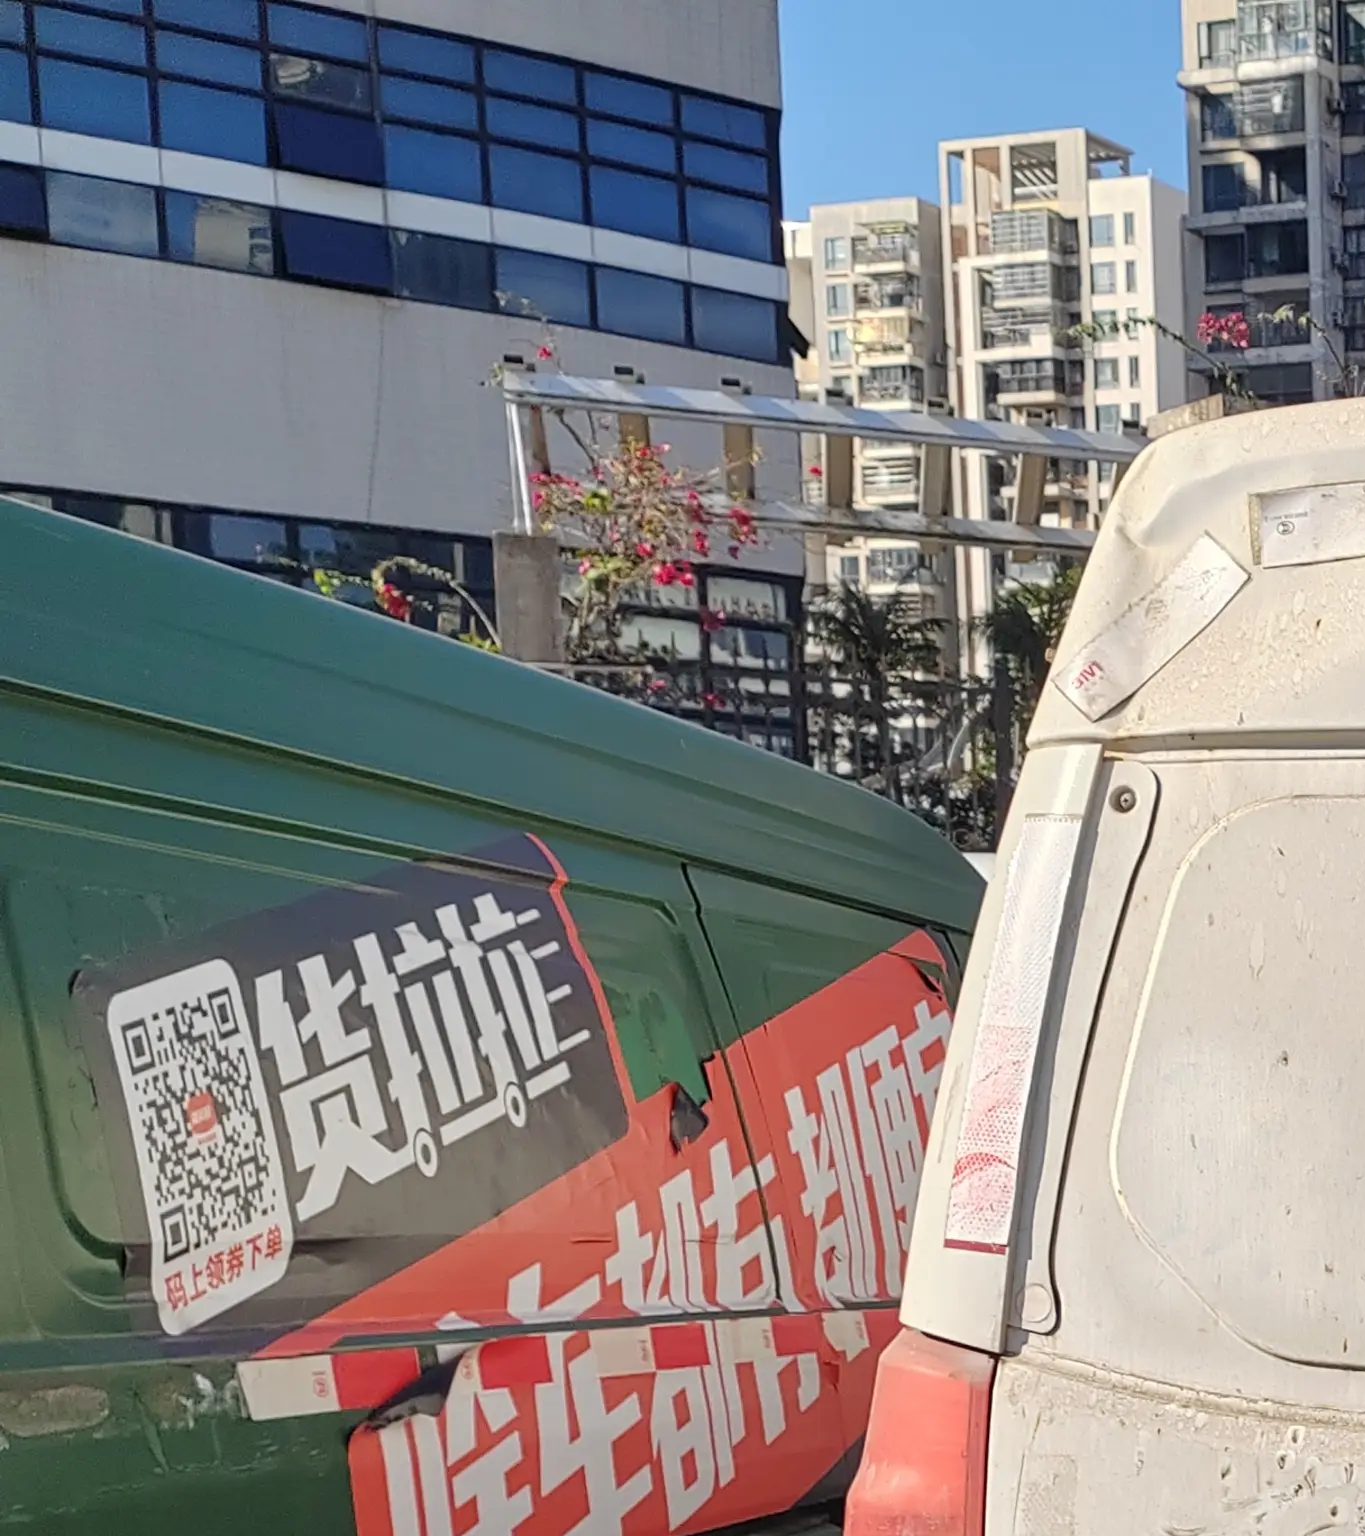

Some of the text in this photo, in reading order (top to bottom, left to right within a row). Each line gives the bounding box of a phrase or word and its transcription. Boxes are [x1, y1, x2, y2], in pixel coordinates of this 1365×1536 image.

[254, 892, 578, 1222] 货拉拉
[164, 1224, 283, 1311] 码上领券下单
